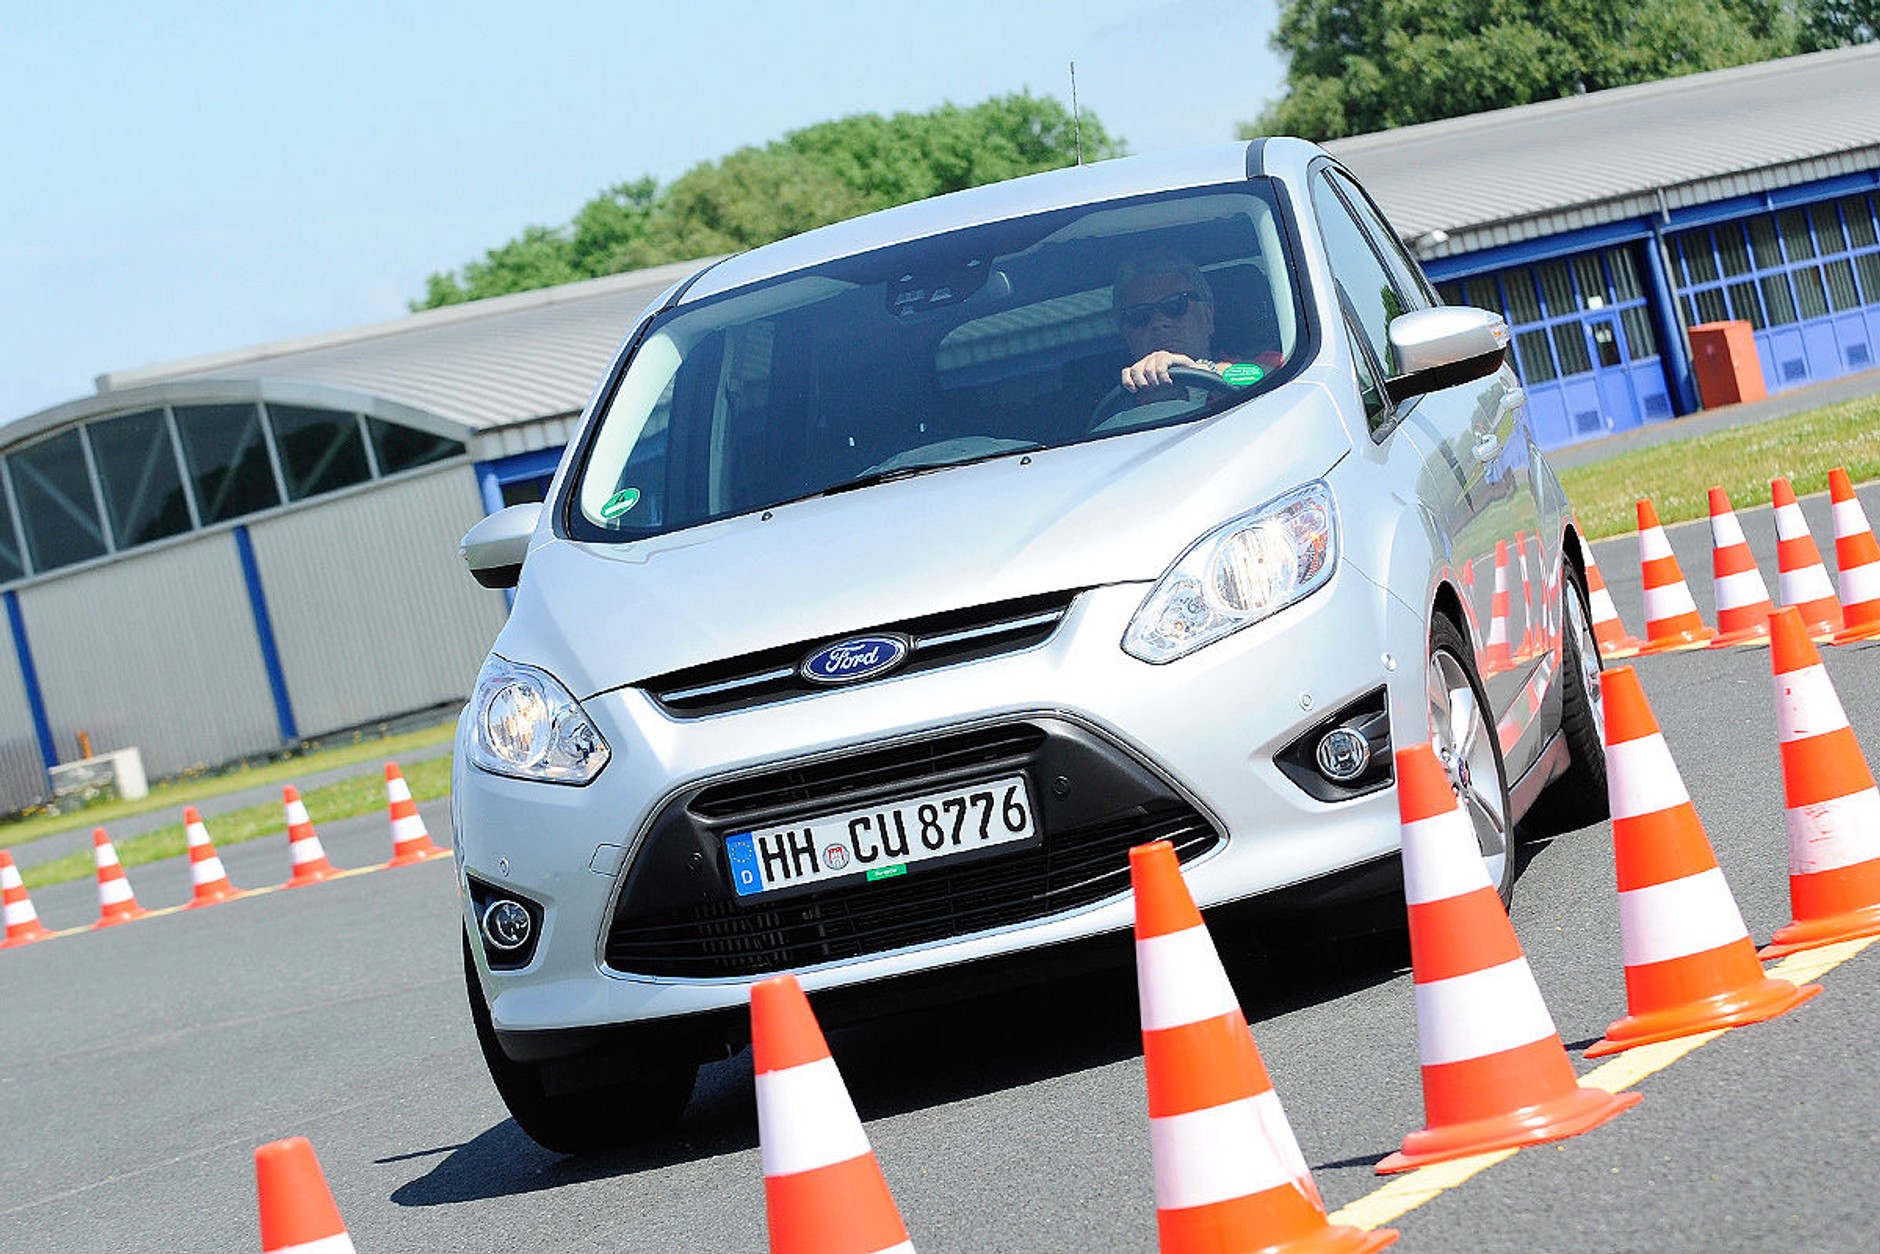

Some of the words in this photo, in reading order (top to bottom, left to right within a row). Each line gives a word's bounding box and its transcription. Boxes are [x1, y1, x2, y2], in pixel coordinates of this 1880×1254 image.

[825, 644, 880, 673] Ford
[759, 827, 820, 882] HH
[848, 809, 910, 864] CU
[917, 785, 1027, 851] 8776
[741, 869, 753, 885] D
